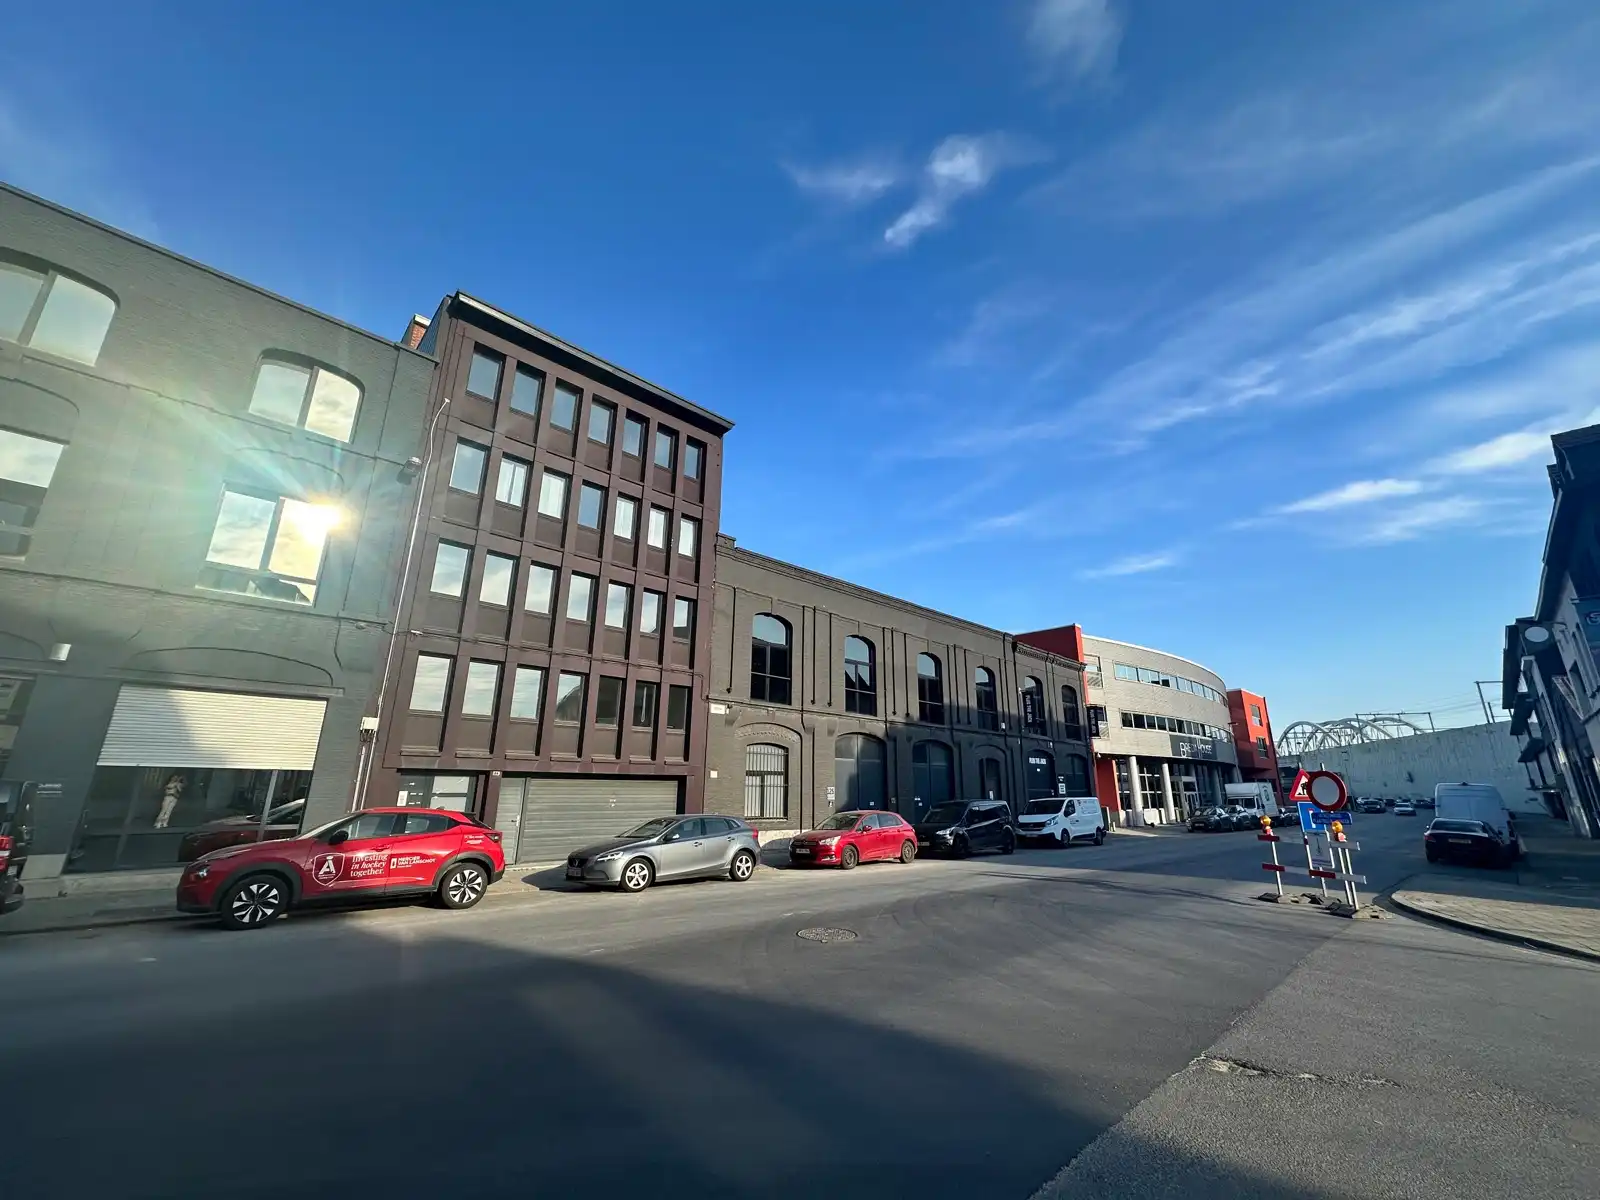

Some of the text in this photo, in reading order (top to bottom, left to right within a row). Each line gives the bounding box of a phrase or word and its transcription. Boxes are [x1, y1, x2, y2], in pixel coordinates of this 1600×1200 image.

[352, 854, 388, 862] Investing
[360, 861, 386, 869] hockey
[350, 868, 384, 877] together.
